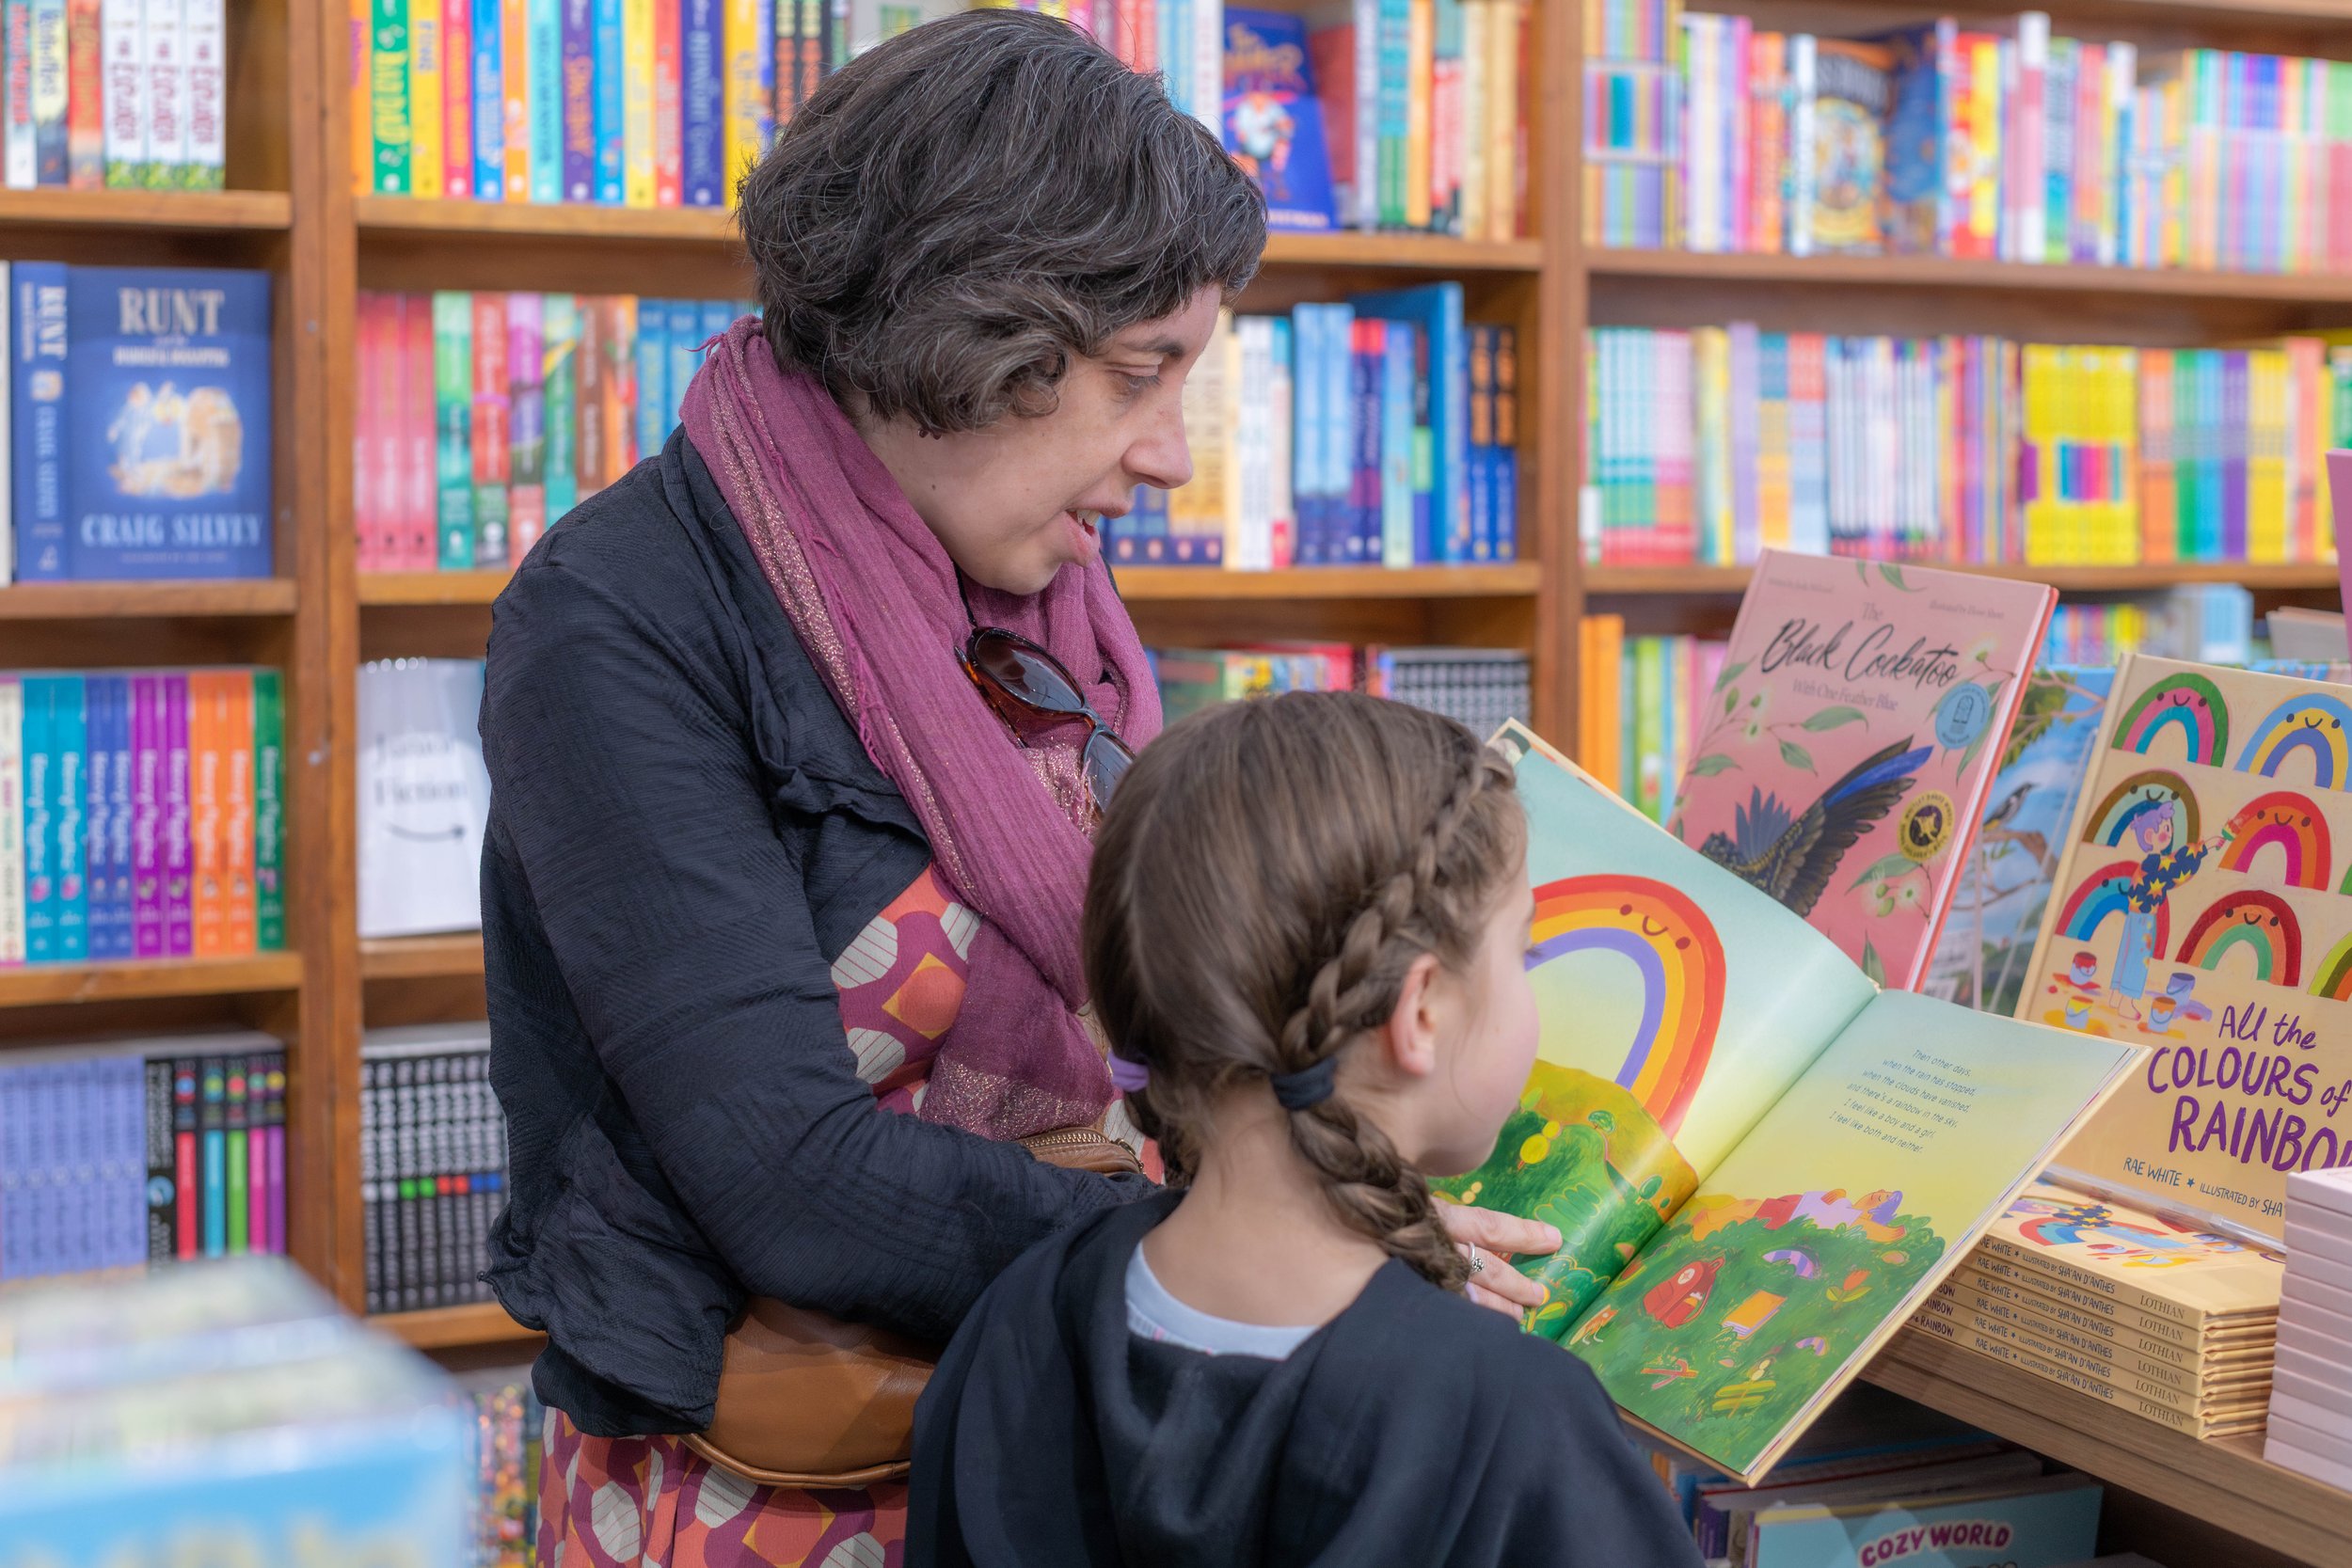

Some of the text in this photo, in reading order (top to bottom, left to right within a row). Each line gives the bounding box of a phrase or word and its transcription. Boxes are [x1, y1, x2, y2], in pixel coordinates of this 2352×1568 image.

[119, 287, 225, 336] RUNT
[81, 513, 263, 547] CRAIG SILVEY
[1761, 618, 1959, 690] Black Cockatoo
[2218, 1001, 2316, 1050] All the
[1883, 1059, 1978, 1097] when the rain has stopped,
[1913, 1050, 1931, 1062] Then
[1931, 1057, 1953, 1069] other
[1862, 1069, 1882, 1081] when
[1882, 1075, 1895, 1086] the
[1895, 1082, 1920, 1096] clouds
[1919, 1090, 1937, 1102] have
[2147, 1046, 2352, 1117] COLOURS of
[1844, 1098, 1851, 1106] I
[1851, 1101, 1866, 1112] feel
[1865, 1105, 1879, 1117] like
[1884, 1114, 1899, 1127] boy
[1899, 1121, 1915, 1132] and
[1847, 1083, 1859, 1092] and
[1861, 1085, 1886, 1101] there's
[1892, 1100, 1921, 1115] rainbow
[1921, 1110, 1931, 1118] in
[1931, 1112, 1945, 1122] the
[1829, 1111, 1836, 1119] I
[1835, 1113, 1851, 1125] feel
[1851, 1118, 1864, 1131] like
[1863, 1125, 1882, 1137] both
[1882, 1133, 1898, 1144] and
[2123, 1157, 2284, 1217] RAE WHITE ILLUSTRATED BY SHA
[1977, 1257, 1990, 1269] RAE
[1991, 1262, 2011, 1277] WHITE
[2021, 1275, 2050, 1291] ILLUSTRATED
[2058, 1287, 2082, 1303] SHA'AN
[2082, 1295, 2115, 1315] D'ANTHES
[1992, 1242, 2011, 1256] WHITE
[2022, 1254, 2050, 1270] ILLUSTRATED
[2058, 1265, 2083, 1282] SHA'AN
[2083, 1275, 2116, 1294] D'ANTHES
[1923, 1298, 1954, 1316] AINBOW
[1977, 1277, 2115, 1337] RAE WHITE ILLUSTRATED BY SHA'AN D'ANTHES
[2139, 1294, 2185, 1319] LOTHIAN
[1920, 1315, 1954, 1337] RAINBOW
[1976, 1297, 2113, 1358] RAE WHITE ILLUSTRATED BY SHA'AN D'ANTHES
[2138, 1316, 2184, 1340] LOTHIAN
[1974, 1316, 2111, 1378] RAE WHITE ILLUSTRATED BY SHA'AN D'ANTHES
[2138, 1338, 2183, 1363] LOTHIAN
[1975, 1338, 2114, 1400] RAE WHITE ILLUSTRATED BY SHA'AN D'ANTHES
[2137, 1359, 2183, 1385] LOTHIAN
[2136, 1379, 2181, 1404] LOTHIAN
[2138, 1401, 2183, 1427] LOTHIAN
[1860, 1523, 2010, 1568] COZY WORLD
